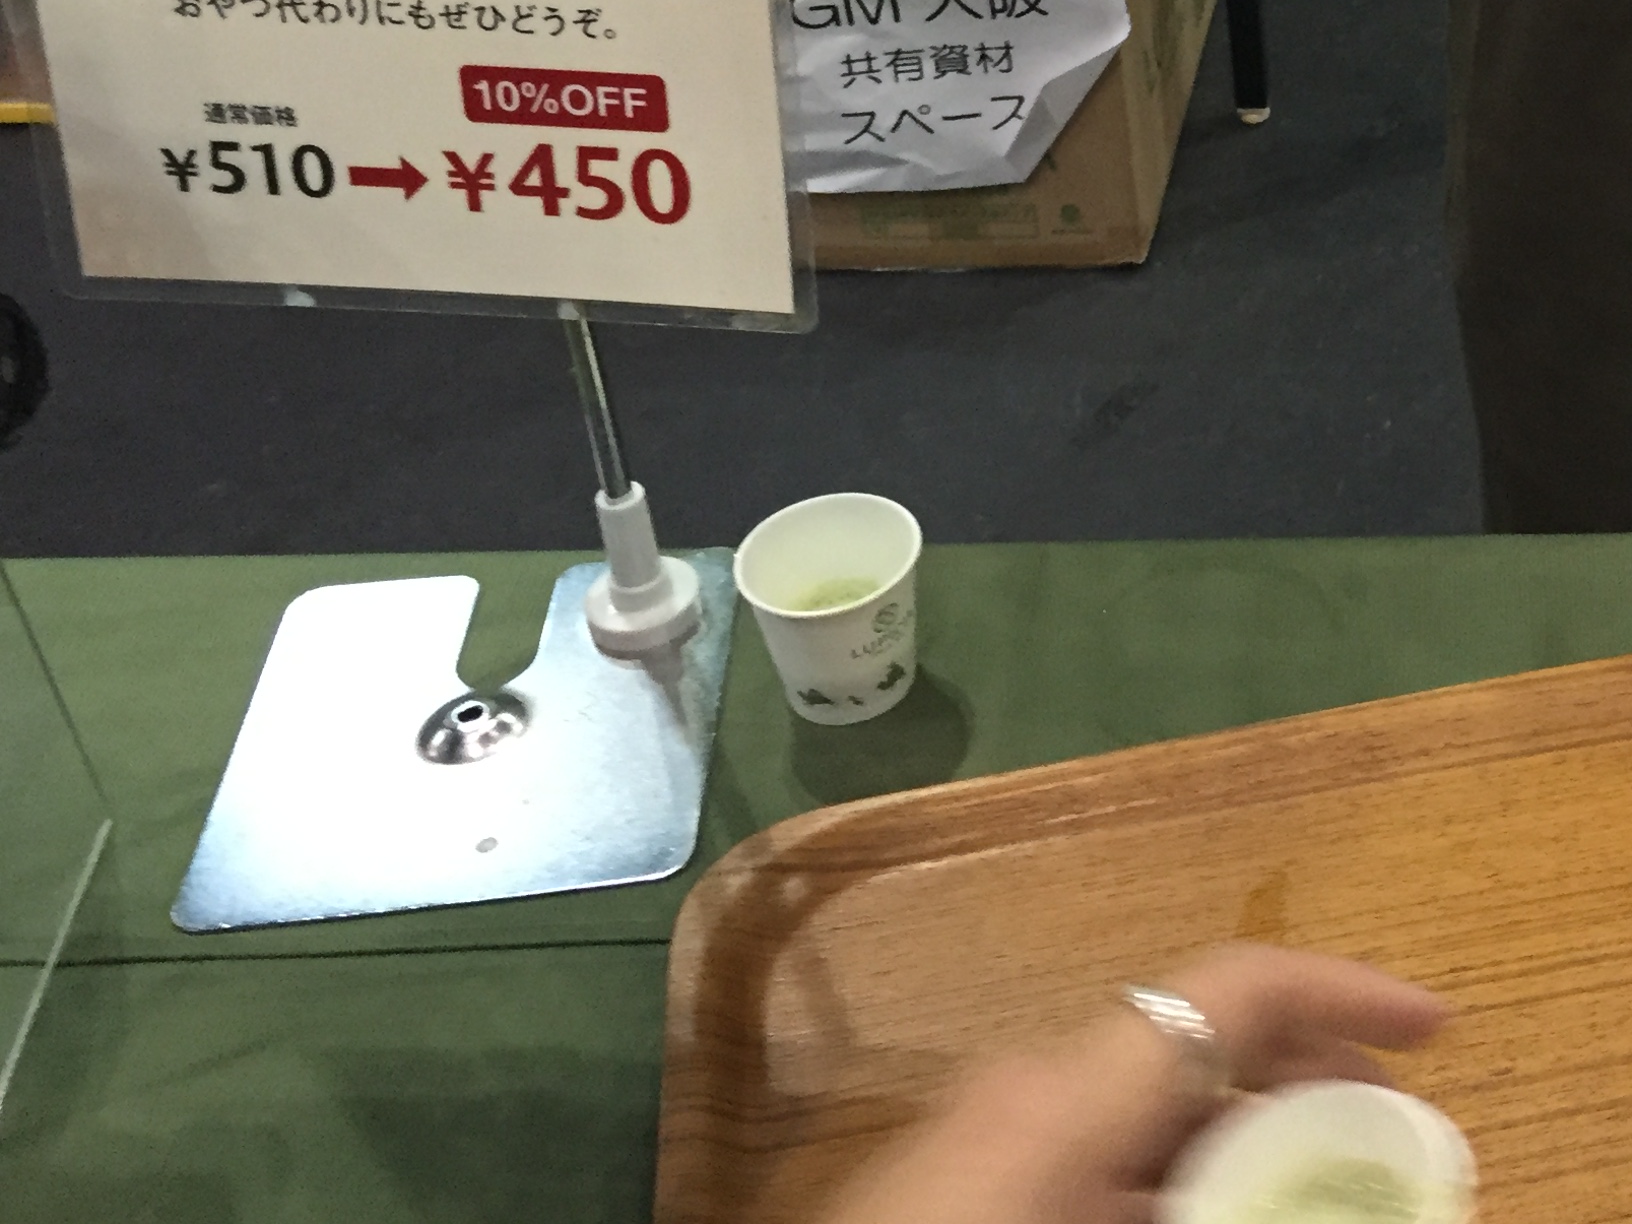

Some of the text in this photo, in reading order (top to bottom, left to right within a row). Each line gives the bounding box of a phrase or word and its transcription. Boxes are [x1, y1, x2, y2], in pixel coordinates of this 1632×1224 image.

[840, 40, 1014, 89] 共有資材
[203, 102, 297, 127] 通常価格
[473, 80, 647, 118] 10%OFF
[840, 95, 1025, 145] スペース
[160, 140, 336, 199] ¥510
[441, 143, 691, 225] ¥450
